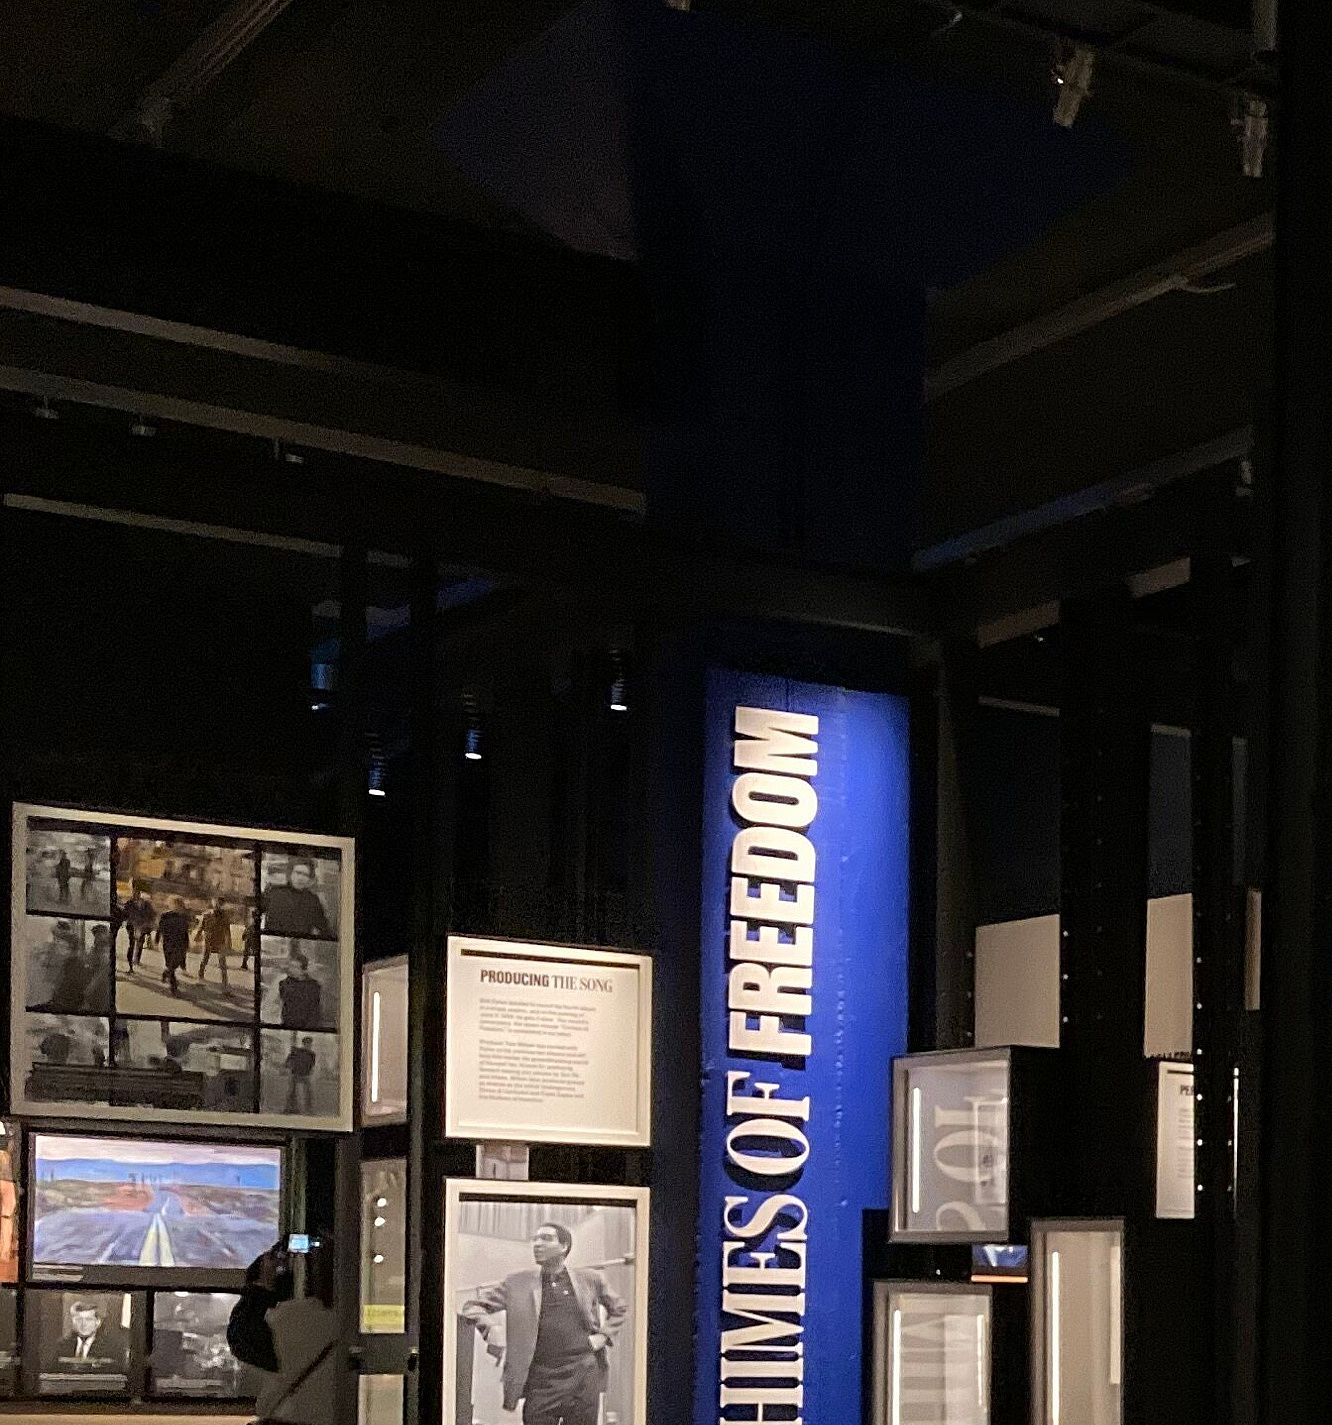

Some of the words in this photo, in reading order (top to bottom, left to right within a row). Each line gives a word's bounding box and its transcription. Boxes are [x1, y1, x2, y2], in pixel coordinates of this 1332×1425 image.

[729, 706, 820, 1057] FREEDOM
[480, 969, 550, 988] PRODUCING
[551, 975, 578, 990] THE
[579, 977, 613, 993] SONG
[726, 1070, 811, 1177] OF
